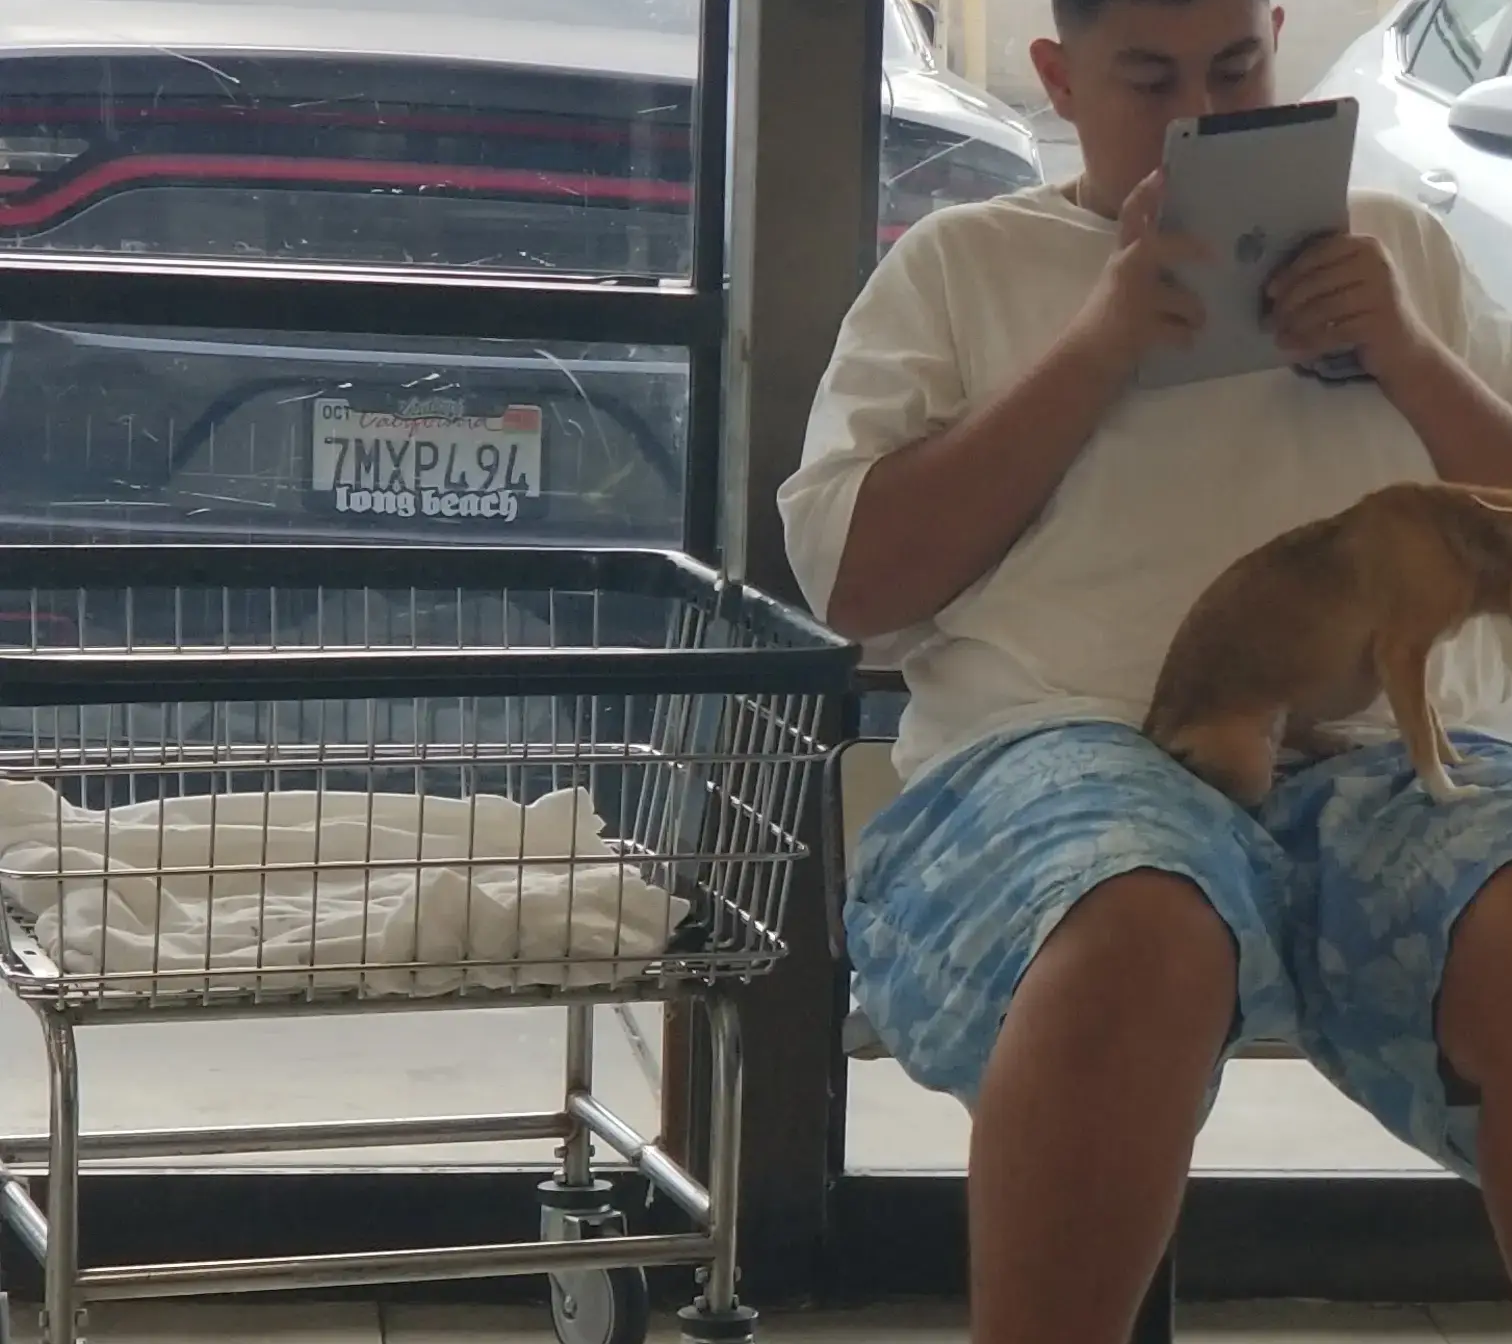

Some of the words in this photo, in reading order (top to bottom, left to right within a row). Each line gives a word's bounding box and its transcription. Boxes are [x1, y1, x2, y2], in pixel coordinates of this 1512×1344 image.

[322, 405, 351, 421] OCT
[324, 437, 531, 491] 7MXP494
[335, 484, 417, 519] long
[421, 485, 519, 523] beach
